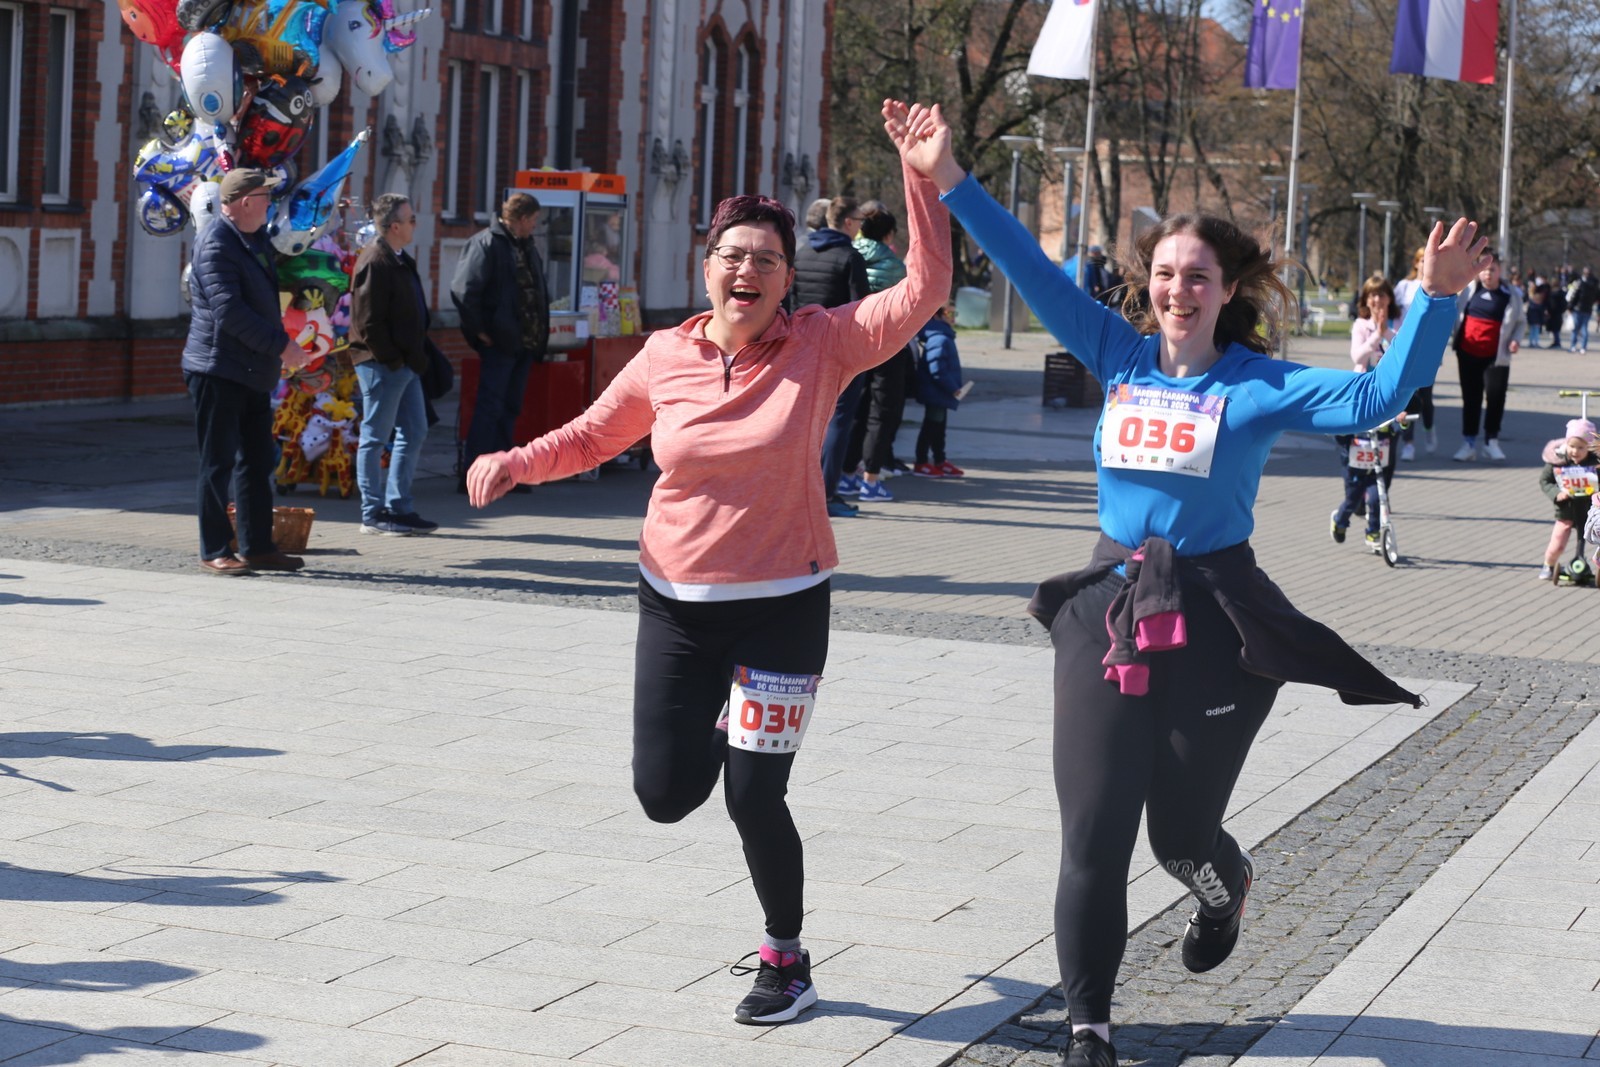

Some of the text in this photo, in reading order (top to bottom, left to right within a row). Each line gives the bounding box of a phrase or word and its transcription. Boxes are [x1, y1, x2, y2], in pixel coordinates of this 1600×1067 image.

[529, 176, 568, 186] POP CORN
[1118, 416, 1196, 453] 036
[1562, 476, 1590, 490] 241
[757, 682, 767, 690] DO
[740, 699, 805, 733] 034
[1205, 703, 1235, 716] adidas
